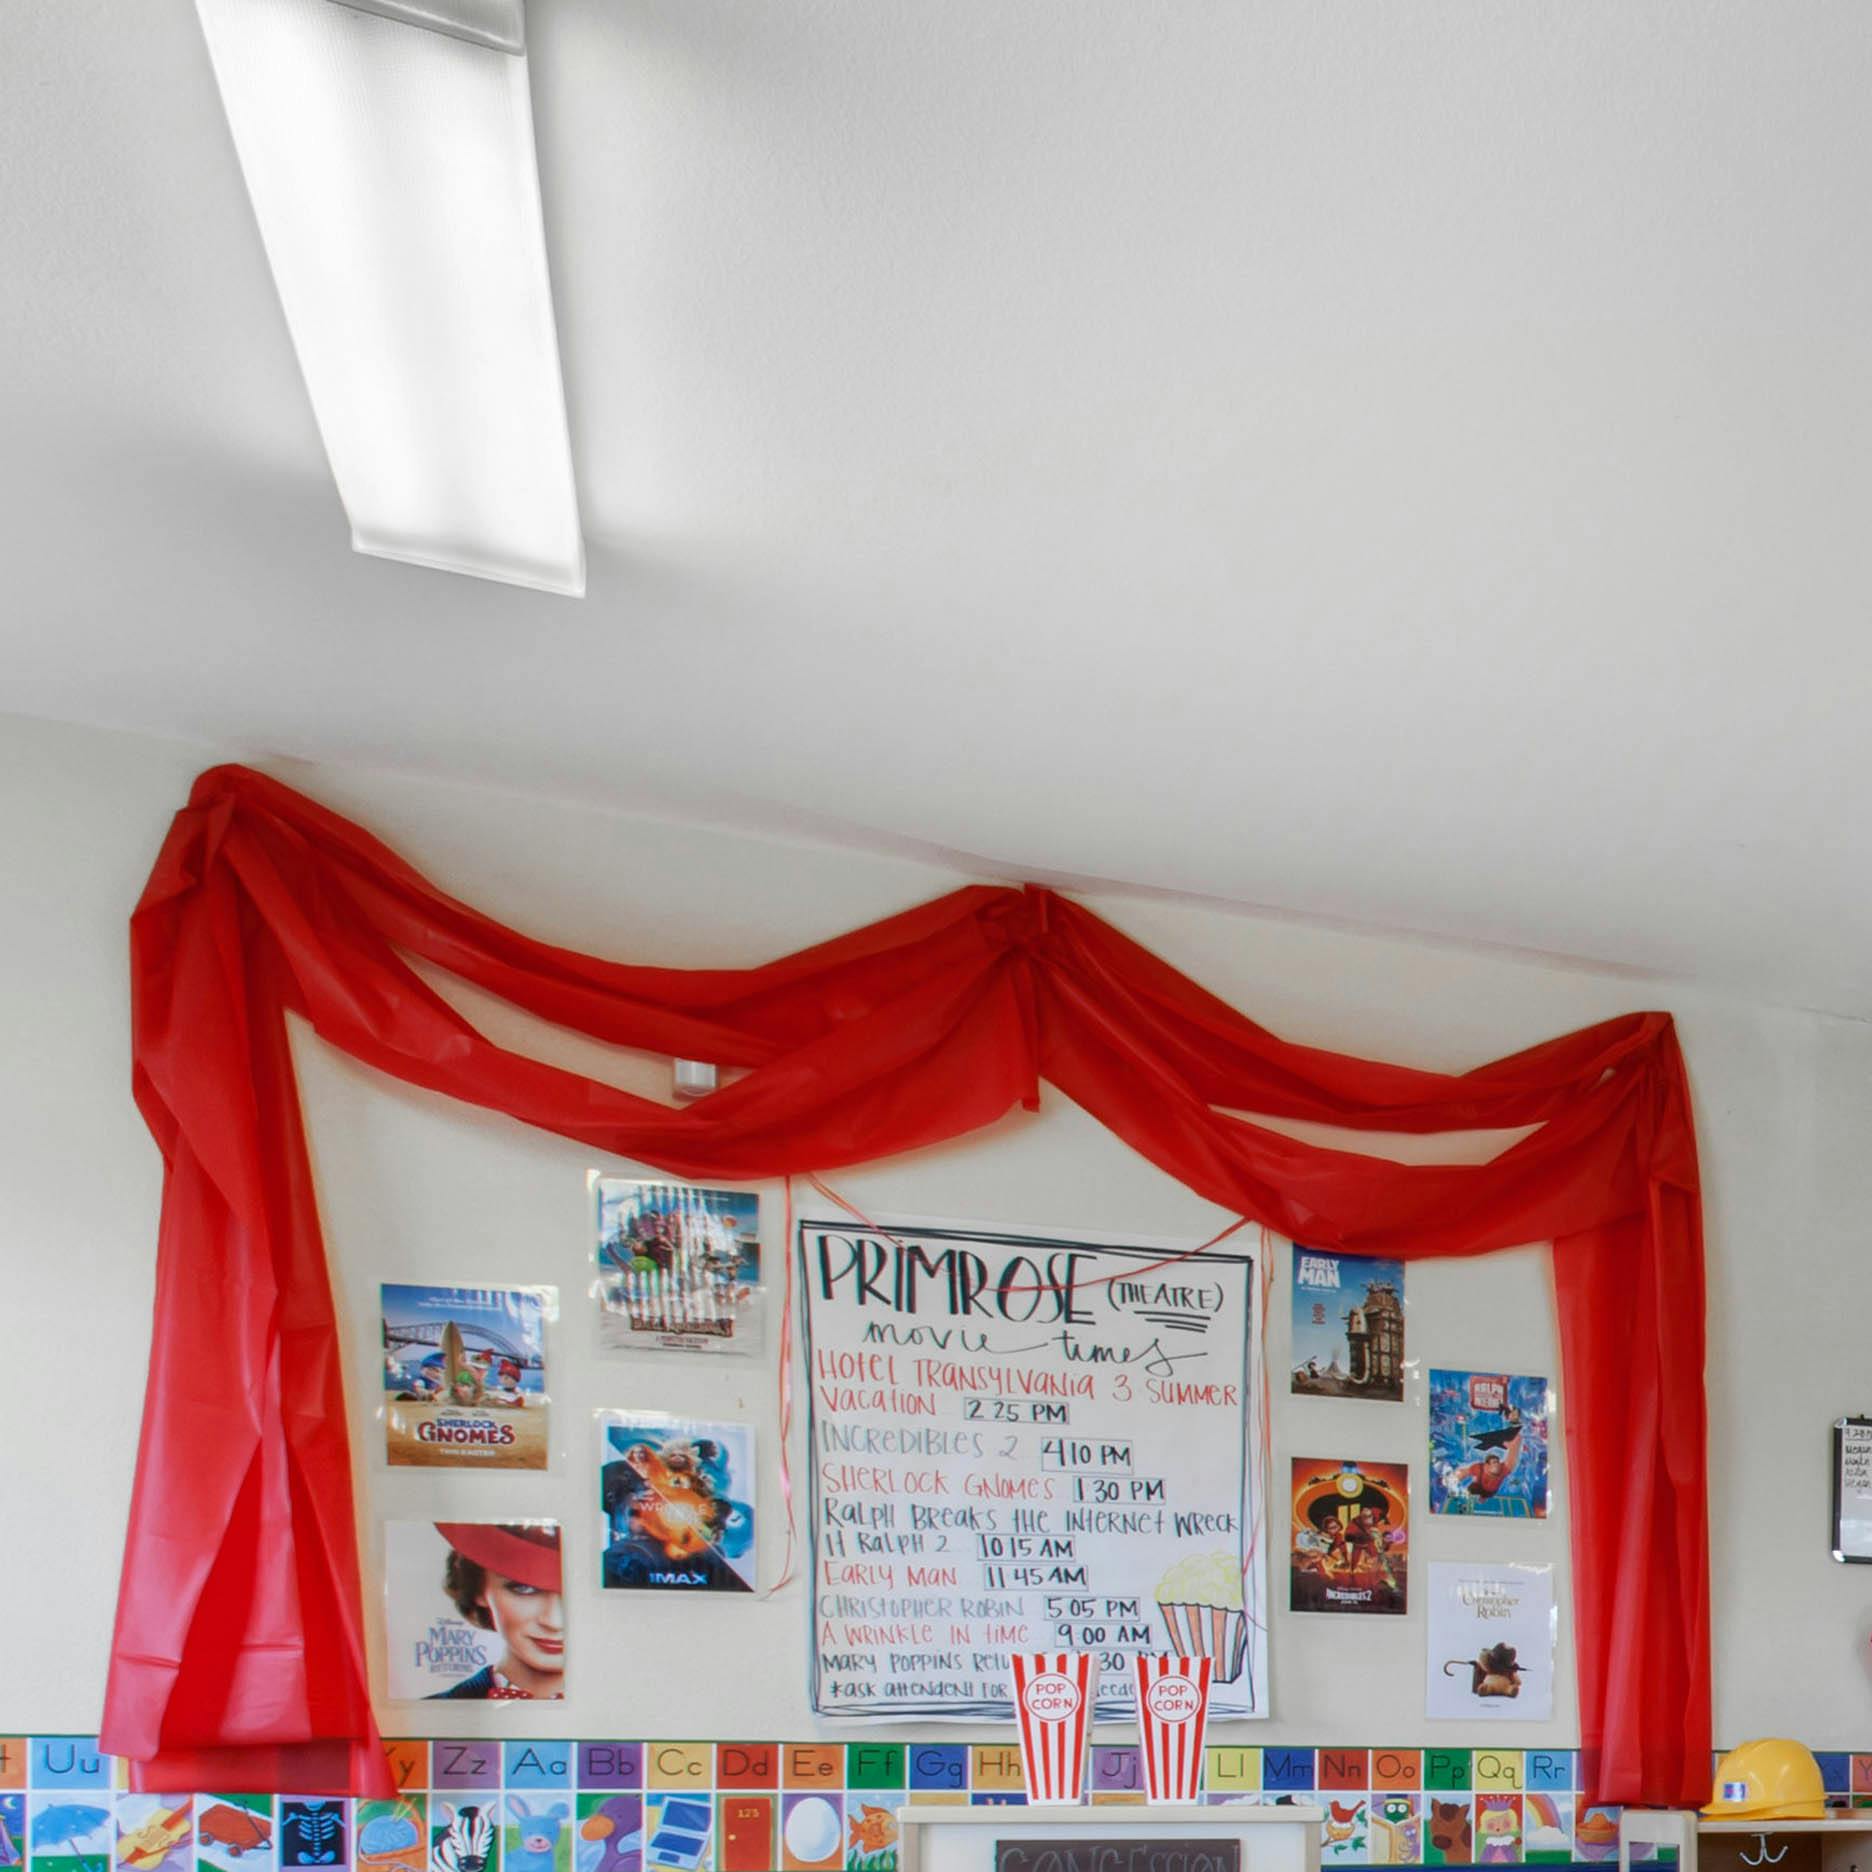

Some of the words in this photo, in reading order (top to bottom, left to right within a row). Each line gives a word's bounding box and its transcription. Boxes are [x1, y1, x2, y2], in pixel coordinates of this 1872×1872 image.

[1300, 1256, 1340, 1270] EARLY
[818, 1235, 1097, 1324] PRIMROSE
[1298, 1268, 1341, 1288] MAN
[863, 1321, 1030, 1353] movie
[1052, 1330, 1207, 1377] times
[1113, 1374, 1132, 1401] 3
[968, 1400, 984, 1419] 2
[1032, 1403, 1066, 1422] PM
[417, 1422, 517, 1446] GNOMES
[437, 1418, 497, 1429] SHERLOCK
[1000, 1435, 1018, 1459] 2
[1101, 1445, 1131, 1466] PM
[1093, 1480, 1119, 1503] 30
[1130, 1480, 1165, 1500] PM
[936, 1535, 950, 1552] 2
[1040, 1539, 1073, 1557] AM
[649, 1573, 708, 1584] IMAX
[1014, 1568, 1042, 1586] 45
[1050, 1567, 1087, 1585] AM
[1048, 1598, 1062, 1618] 5
[1070, 1598, 1096, 1617] 05
[1106, 1600, 1138, 1617] PM
[822, 1621, 836, 1646] A
[950, 1624, 971, 1644] IN
[1058, 1624, 1073, 1646] 9
[1082, 1626, 1105, 1645] 00
[1118, 1626, 1150, 1644] AM
[415, 1641, 487, 1667] POPPINS
[1036, 1683, 1066, 1695] POP
[1159, 1684, 1188, 1696] POP
[1032, 1699, 1073, 1710] CORN
[1155, 1700, 1194, 1710] CORN
[45, 1743, 99, 1774] Uu
[444, 1747, 487, 1775] Zz
[512, 1748, 568, 1776] Aa
[588, 1749, 635, 1776] Bb
[657, 1749, 703, 1776] Cc
[723, 1750, 768, 1776] Dd
[793, 1750, 833, 1776] Ee
[857, 1750, 897, 1776] Ff
[916, 1752, 963, 1789] Gg
[979, 1752, 1021, 1776] Hh
[1102, 1752, 1137, 1789] Jj
[1264, 1754, 1314, 1777] Mm
[1323, 1755, 1361, 1779] Nn
[1377, 1755, 1415, 1779] Oo
[1432, 1755, 1465, 1789] Pp
[1477, 1755, 1522, 1790] Qq
[1533, 1755, 1565, 1779] Rr
